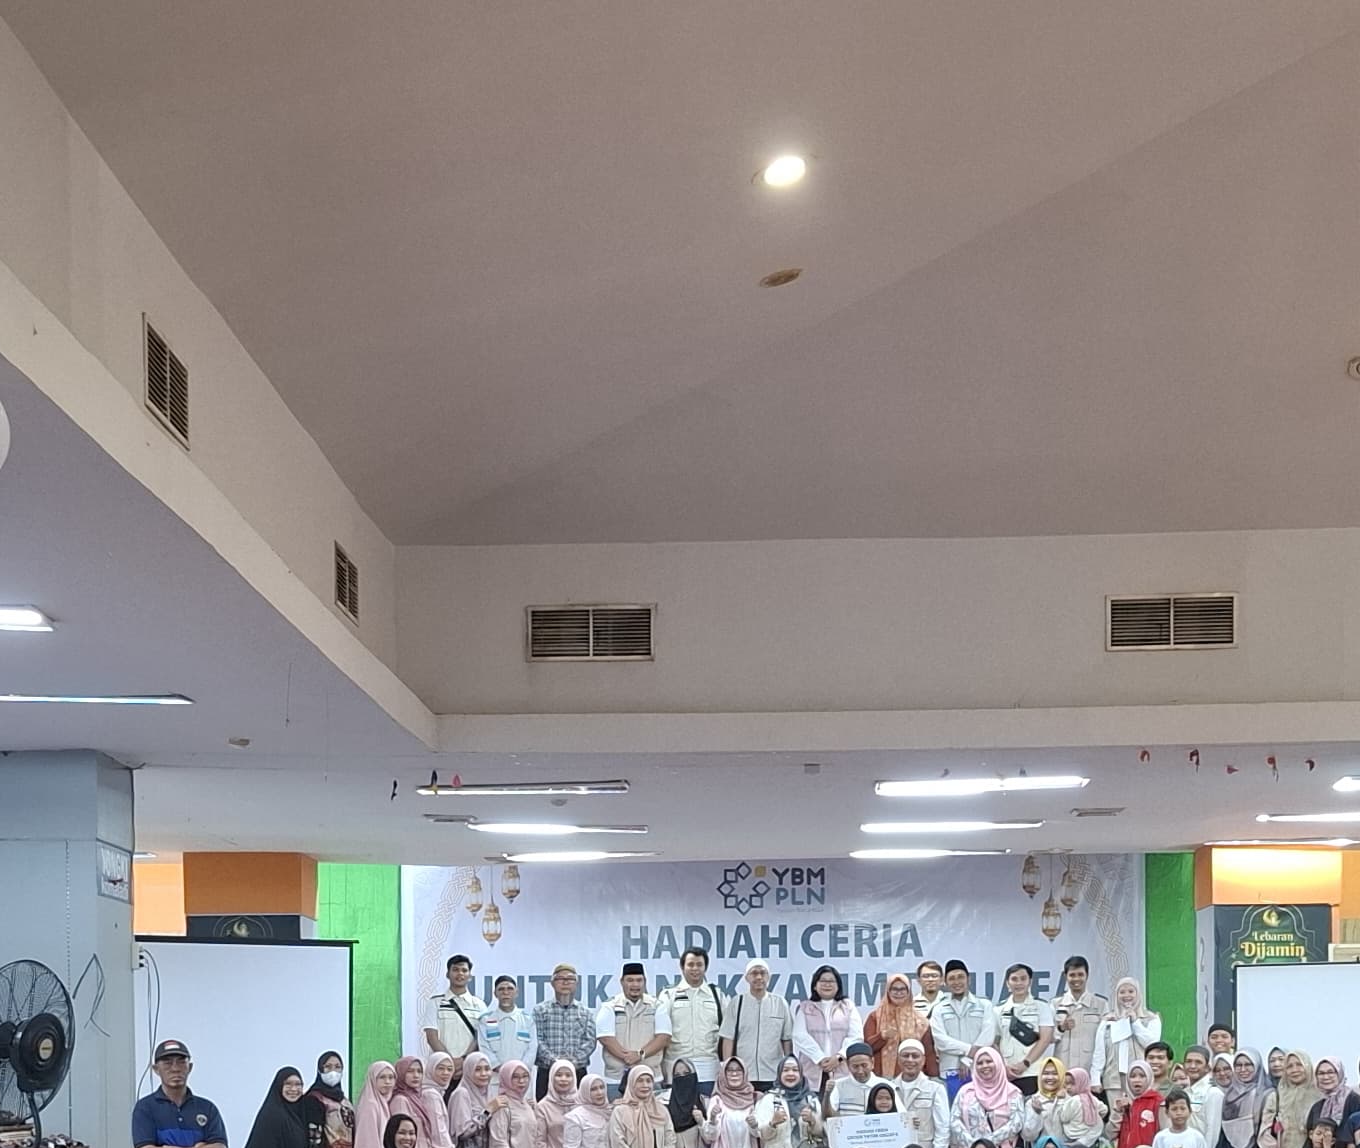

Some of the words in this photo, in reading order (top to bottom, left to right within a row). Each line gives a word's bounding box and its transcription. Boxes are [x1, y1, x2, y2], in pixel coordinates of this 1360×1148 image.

[771, 867, 826, 886] YBM
[775, 886, 826, 906] PLN
[621, 924, 788, 960] HADIAH
[800, 922, 924, 959] CERIA
[1251, 931, 1294, 942] Lebaran
[1240, 941, 1307, 960] Dijamin
